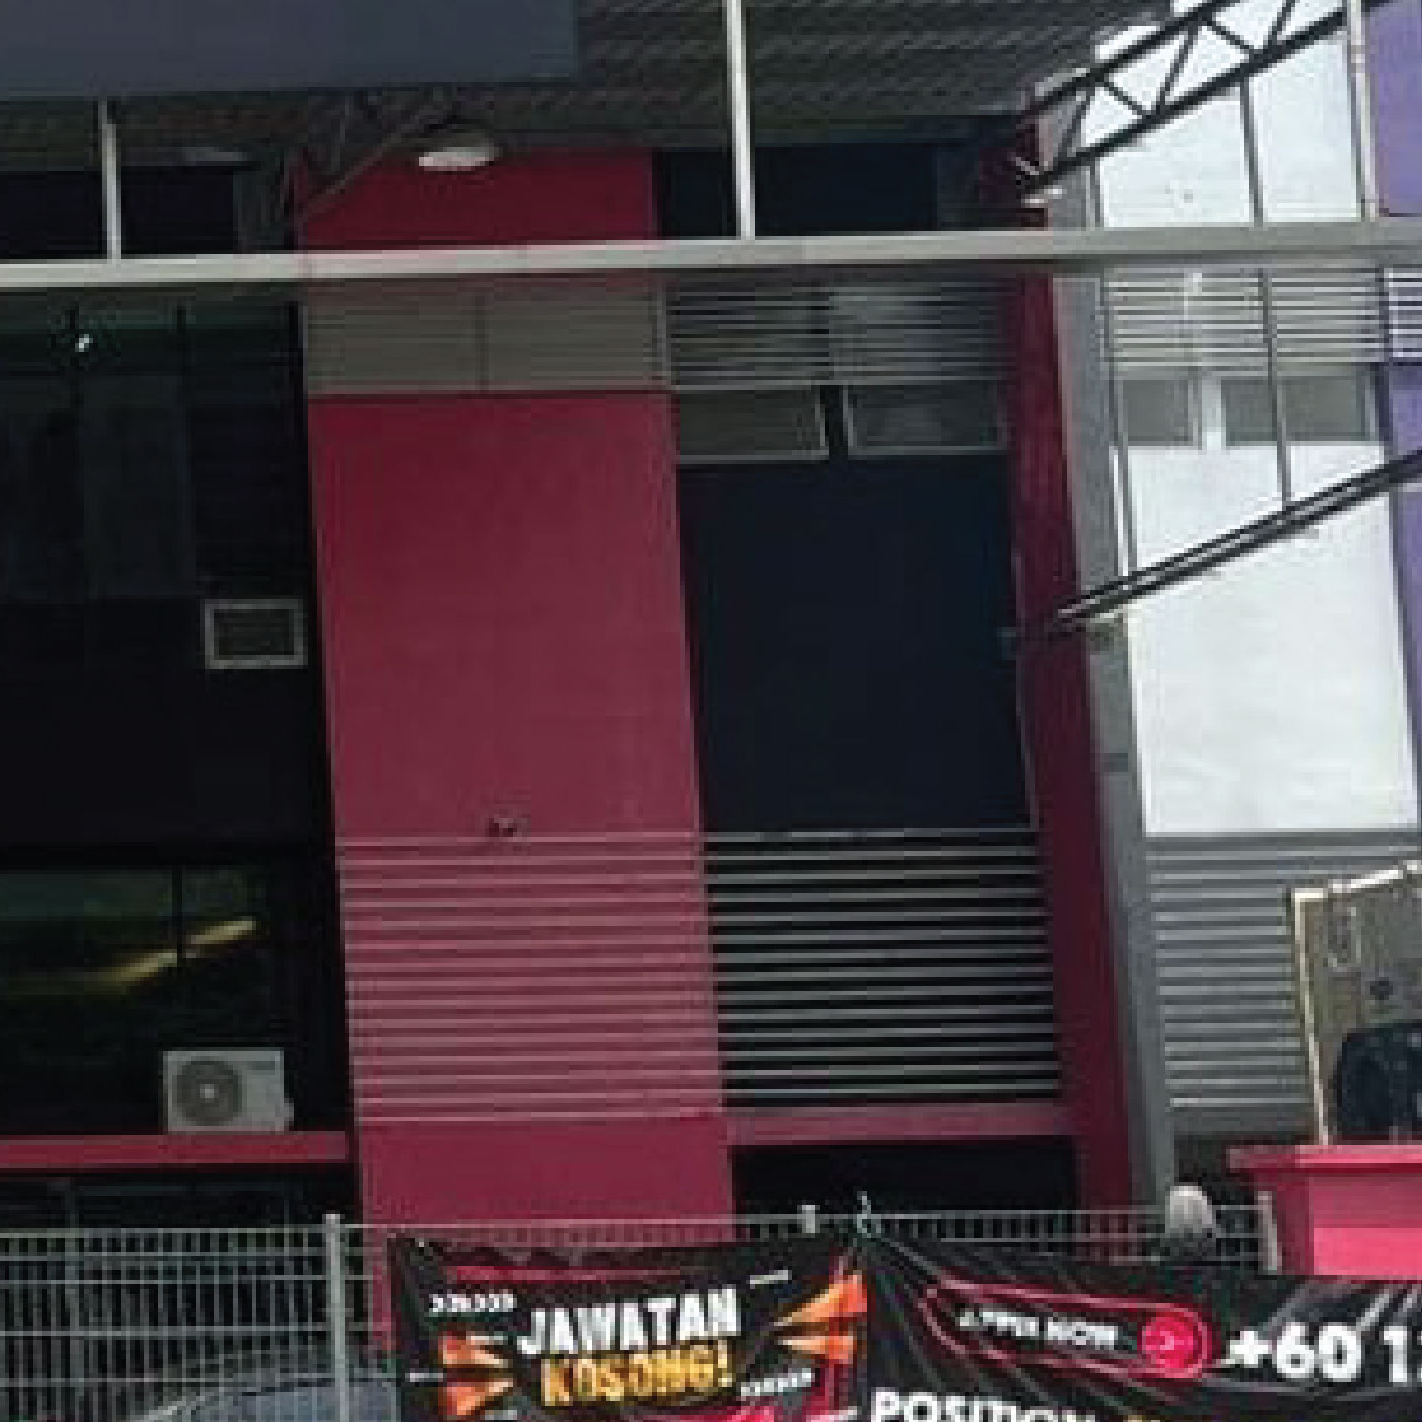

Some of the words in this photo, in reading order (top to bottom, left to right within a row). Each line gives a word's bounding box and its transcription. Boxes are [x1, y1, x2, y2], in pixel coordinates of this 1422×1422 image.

[517, 1285, 742, 1355] JAWATAN
[1228, 1322, 1362, 1382] +60
[1381, 1324, 1422, 1385] 1
[541, 1339, 735, 1407] KOSONG!
